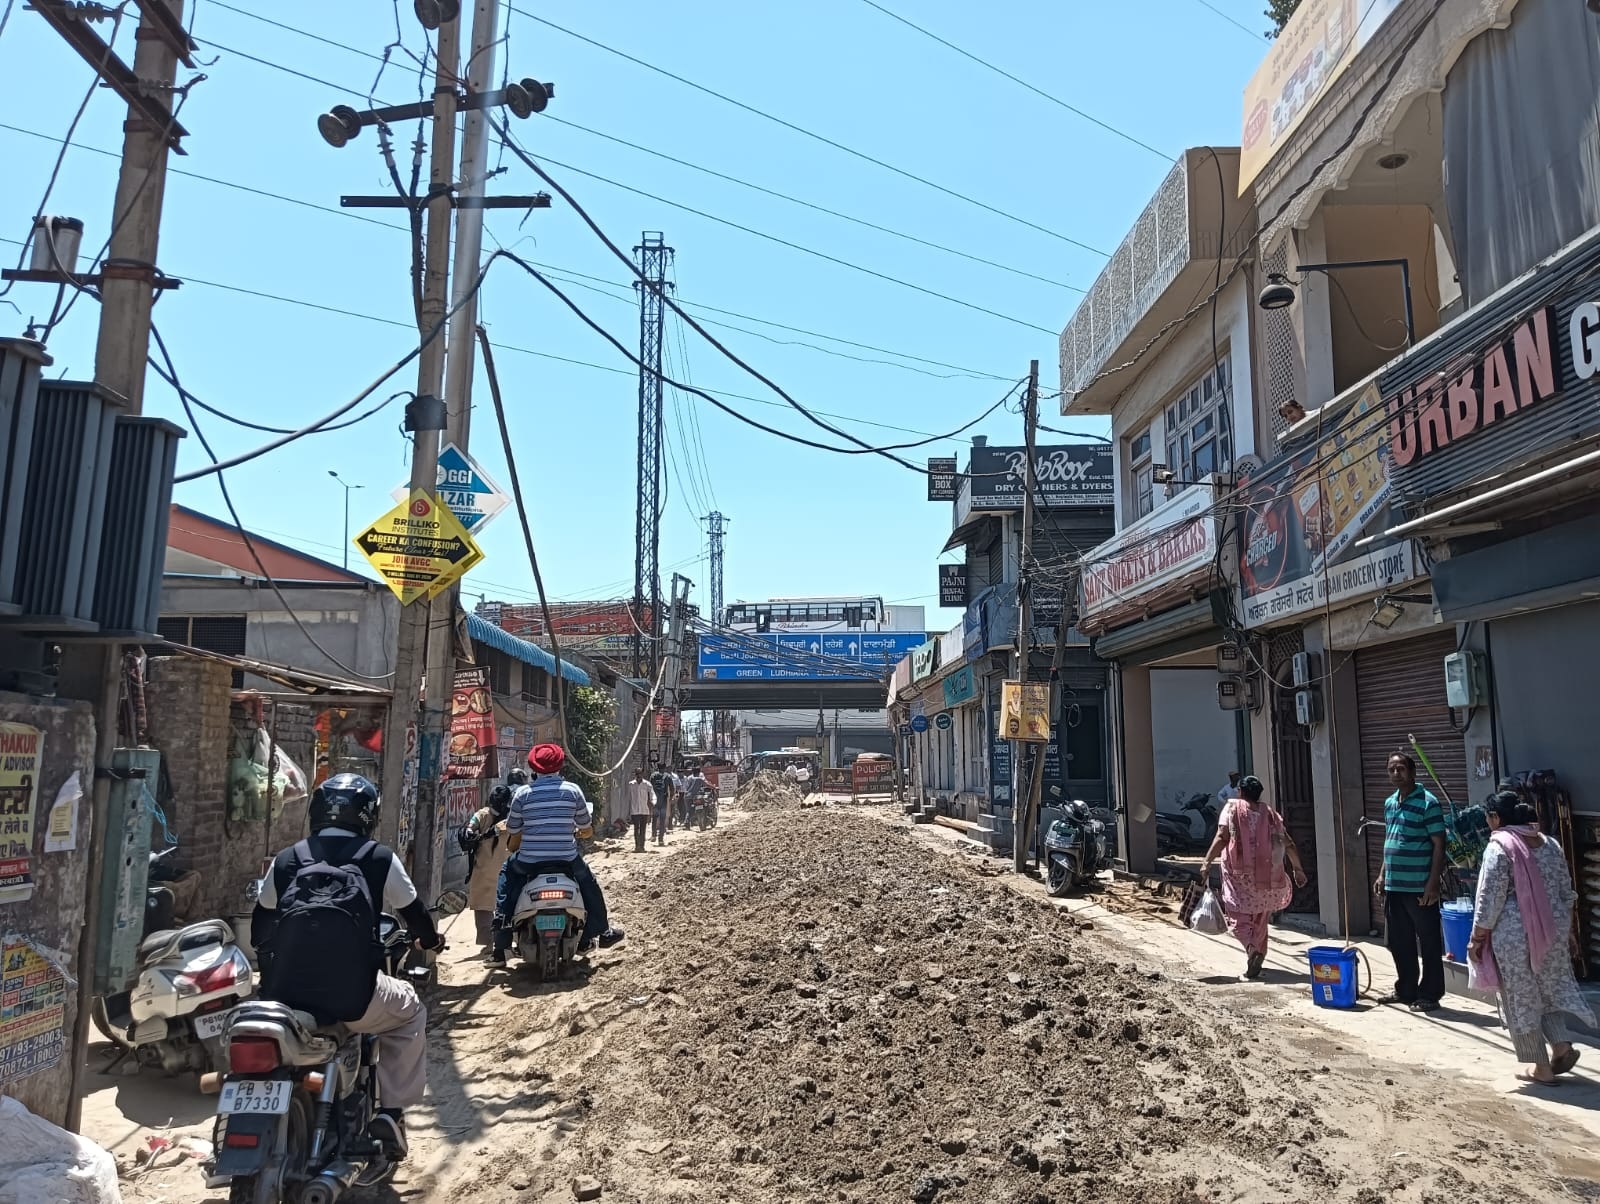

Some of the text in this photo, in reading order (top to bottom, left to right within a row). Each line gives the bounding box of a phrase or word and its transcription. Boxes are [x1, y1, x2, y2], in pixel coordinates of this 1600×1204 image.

[1389, 301, 1600, 465] URBAN G
[1004, 450, 1094, 481] BdBox
[448, 469, 472, 484] GGI
[935, 480, 952, 489] BOX
[995, 484, 1016, 492] DRY
[1018, 483, 1068, 492] CNERS
[1082, 482, 1113, 490] DYERS
[441, 491, 475, 507] LZAR
[393, 517, 440, 529] BRILLIKO
[391, 526, 440, 537] INSTITUTES
[366, 533, 460, 551] CAREER KA CONFUSION?
[1246, 530, 1278, 567] CHARGED
[392, 555, 431, 567] JOIN AVGC
[1084, 568, 1106, 606] SANT
[1107, 551, 1146, 594] SWEETS
[1157, 519, 1207, 569] BAKERS
[941, 576, 966, 586] PAJNI
[1317, 553, 1405, 597] URBAN GROCERY STORE
[942, 587, 965, 595] DENTAL
[944, 594, 963, 602] CLINIC
[736, 669, 763, 677] GREEN
[0, 733, 37, 754] HAKUR
[4, 756, 35, 771] ADVISOR
[856, 764, 886, 774] POLICE
[202, 1013, 234, 1026] PB10
[264, 1082, 282, 1096] 91
[233, 1097, 280, 1111] B7330
